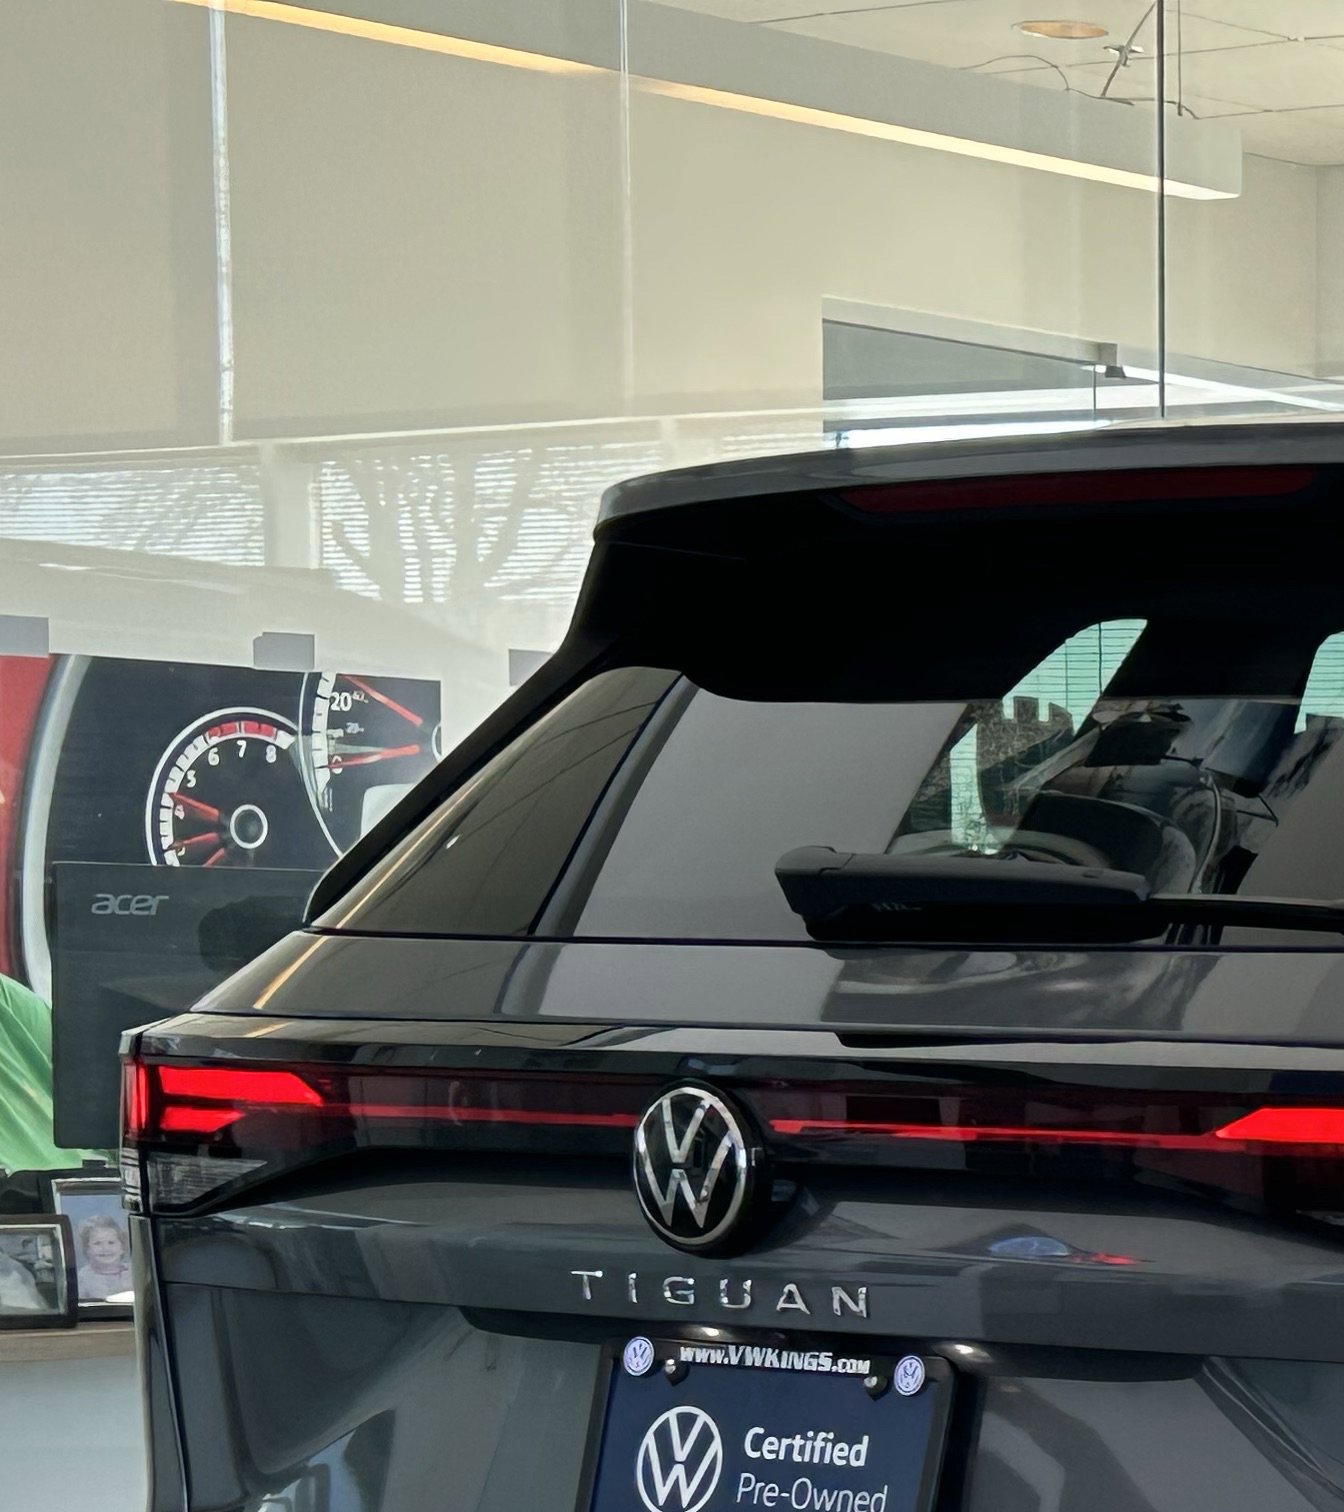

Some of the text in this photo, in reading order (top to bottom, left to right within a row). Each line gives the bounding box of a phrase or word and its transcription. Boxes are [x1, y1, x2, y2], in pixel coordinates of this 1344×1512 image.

[330, 692, 353, 712] 20
[208, 747, 220, 766] 6
[237, 740, 247, 758] 7
[265, 744, 277, 764] 8
[91, 893, 170, 917] acer
[570, 1270, 872, 1319] TIGUAN
[744, 1426, 870, 1468] Certified
